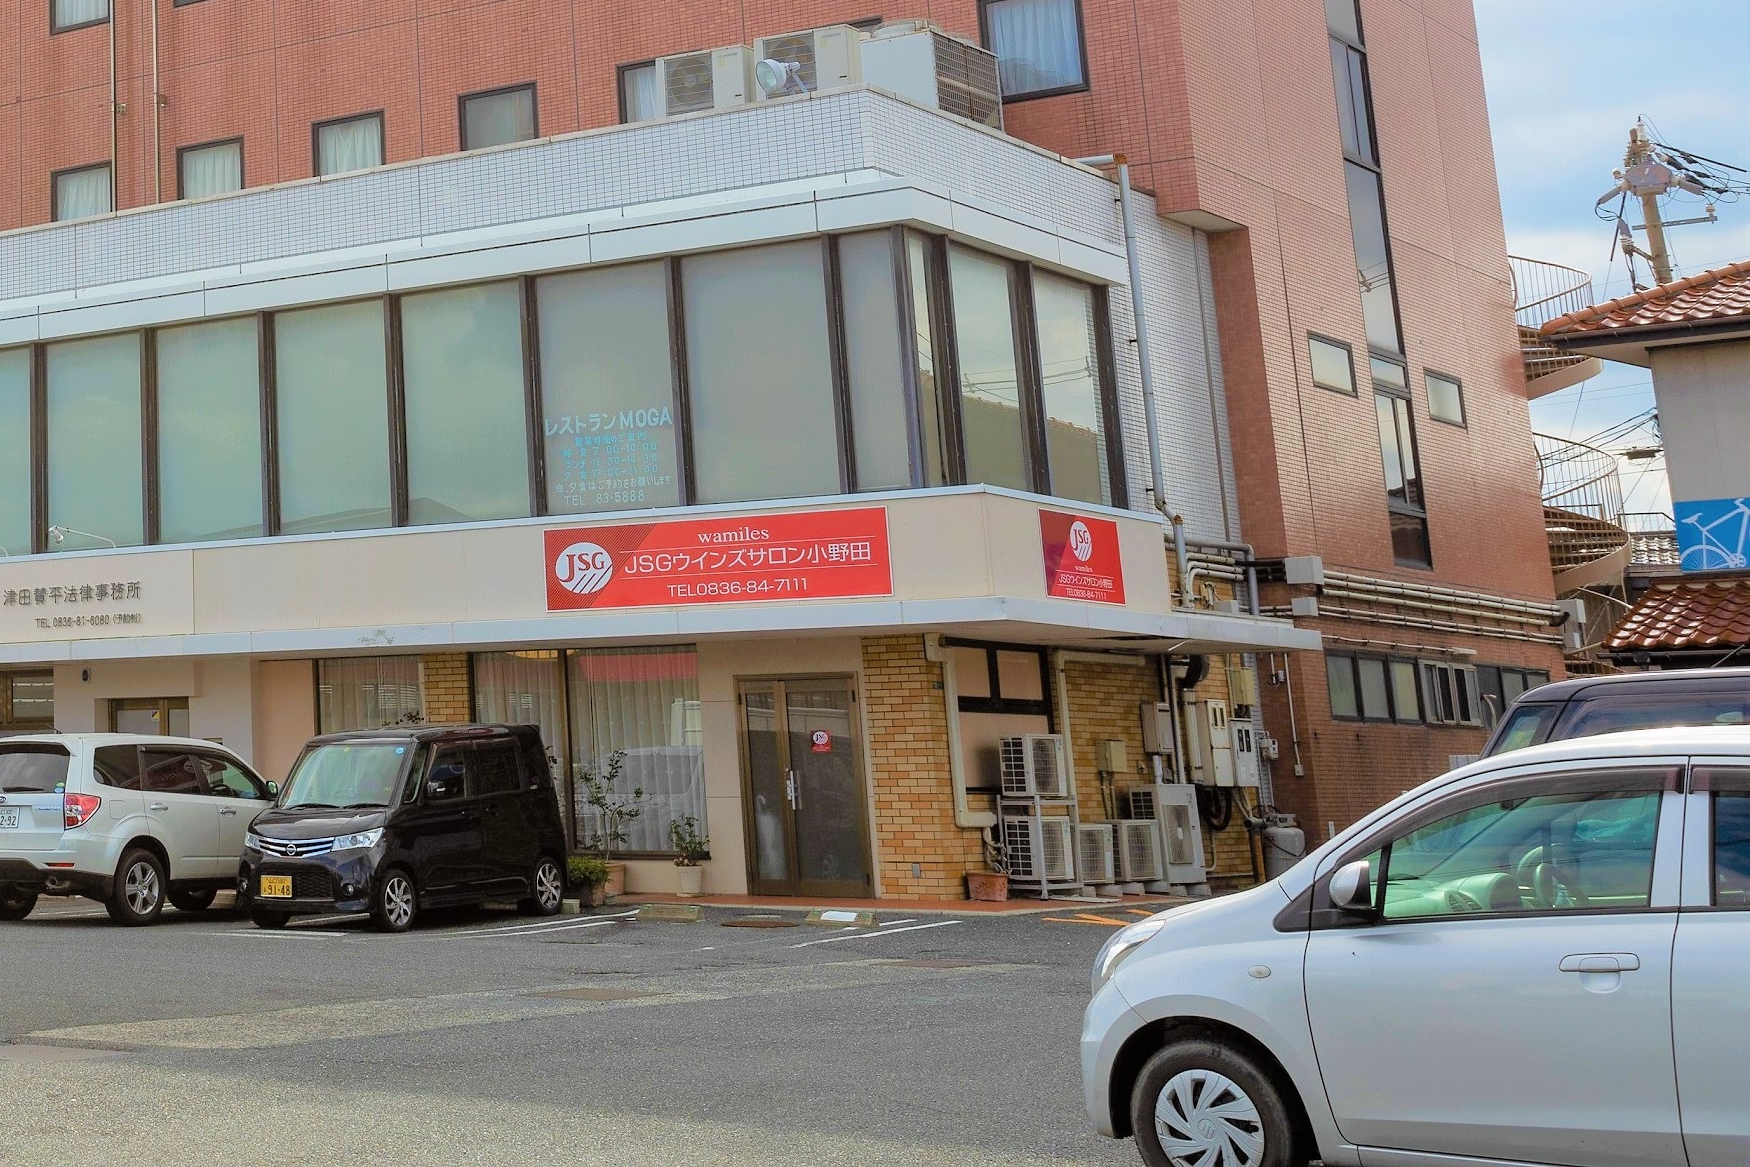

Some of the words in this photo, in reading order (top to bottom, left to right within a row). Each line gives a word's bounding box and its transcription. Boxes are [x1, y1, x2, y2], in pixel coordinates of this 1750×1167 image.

[565, 495, 586, 506] TEL
[596, 490, 645, 504] 83-5888
[697, 525, 770, 545] wamiles
[1072, 528, 1089, 551] JSG
[556, 551, 606, 583] JSG
[624, 541, 872, 575] JSGウインズサロン小野田
[666, 577, 808, 598] TEL0836-84-7111
[35, 617, 51, 628] TEL
[52, 614, 110, 627] 0836-81-6080
